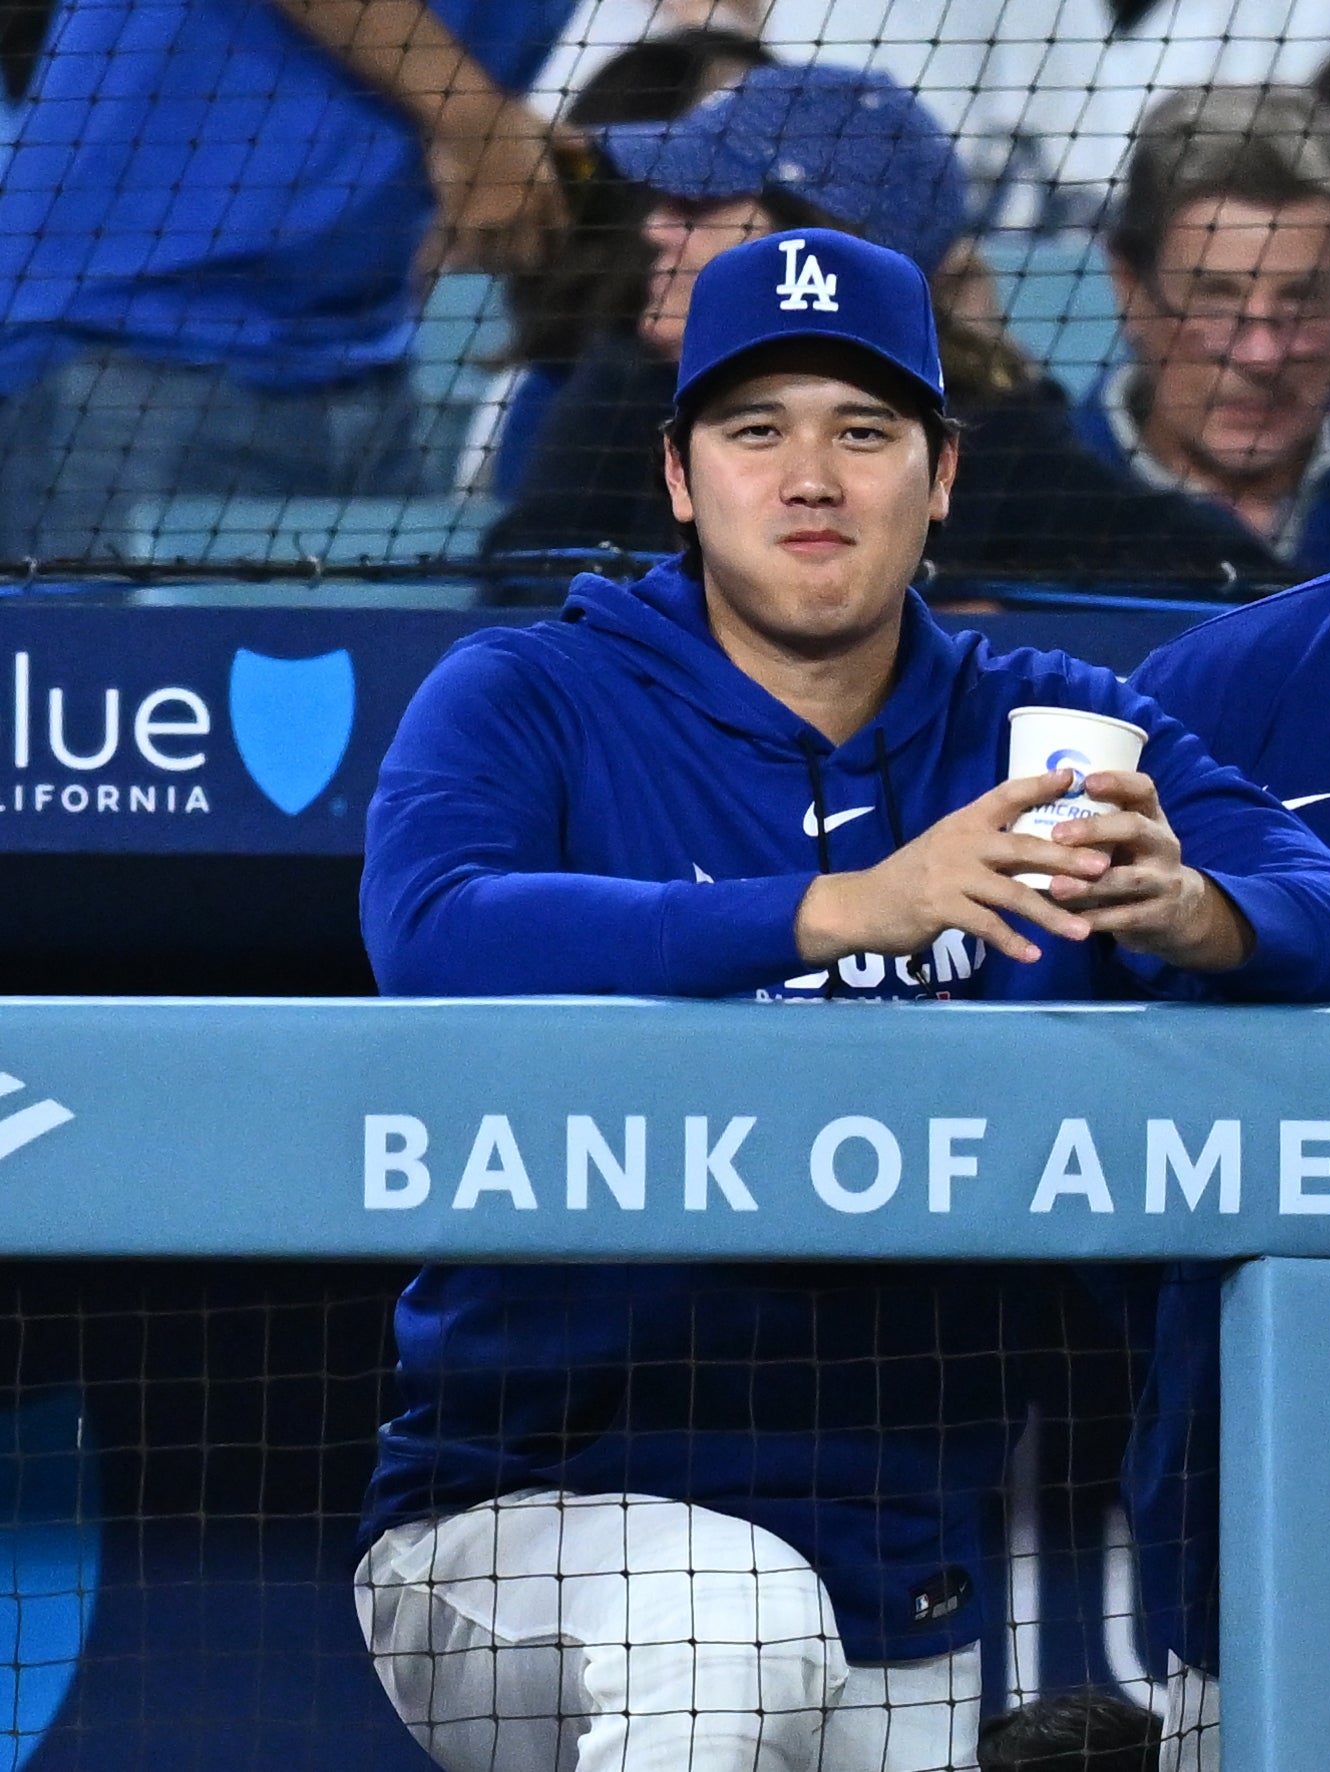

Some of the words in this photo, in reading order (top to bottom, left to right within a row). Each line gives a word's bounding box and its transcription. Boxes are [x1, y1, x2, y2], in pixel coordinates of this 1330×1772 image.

[776, 238, 839, 312] LA
[15, 651, 210, 771] lue
[363, 1114, 760, 1211] BANK
[809, 1115, 988, 1214] OF
